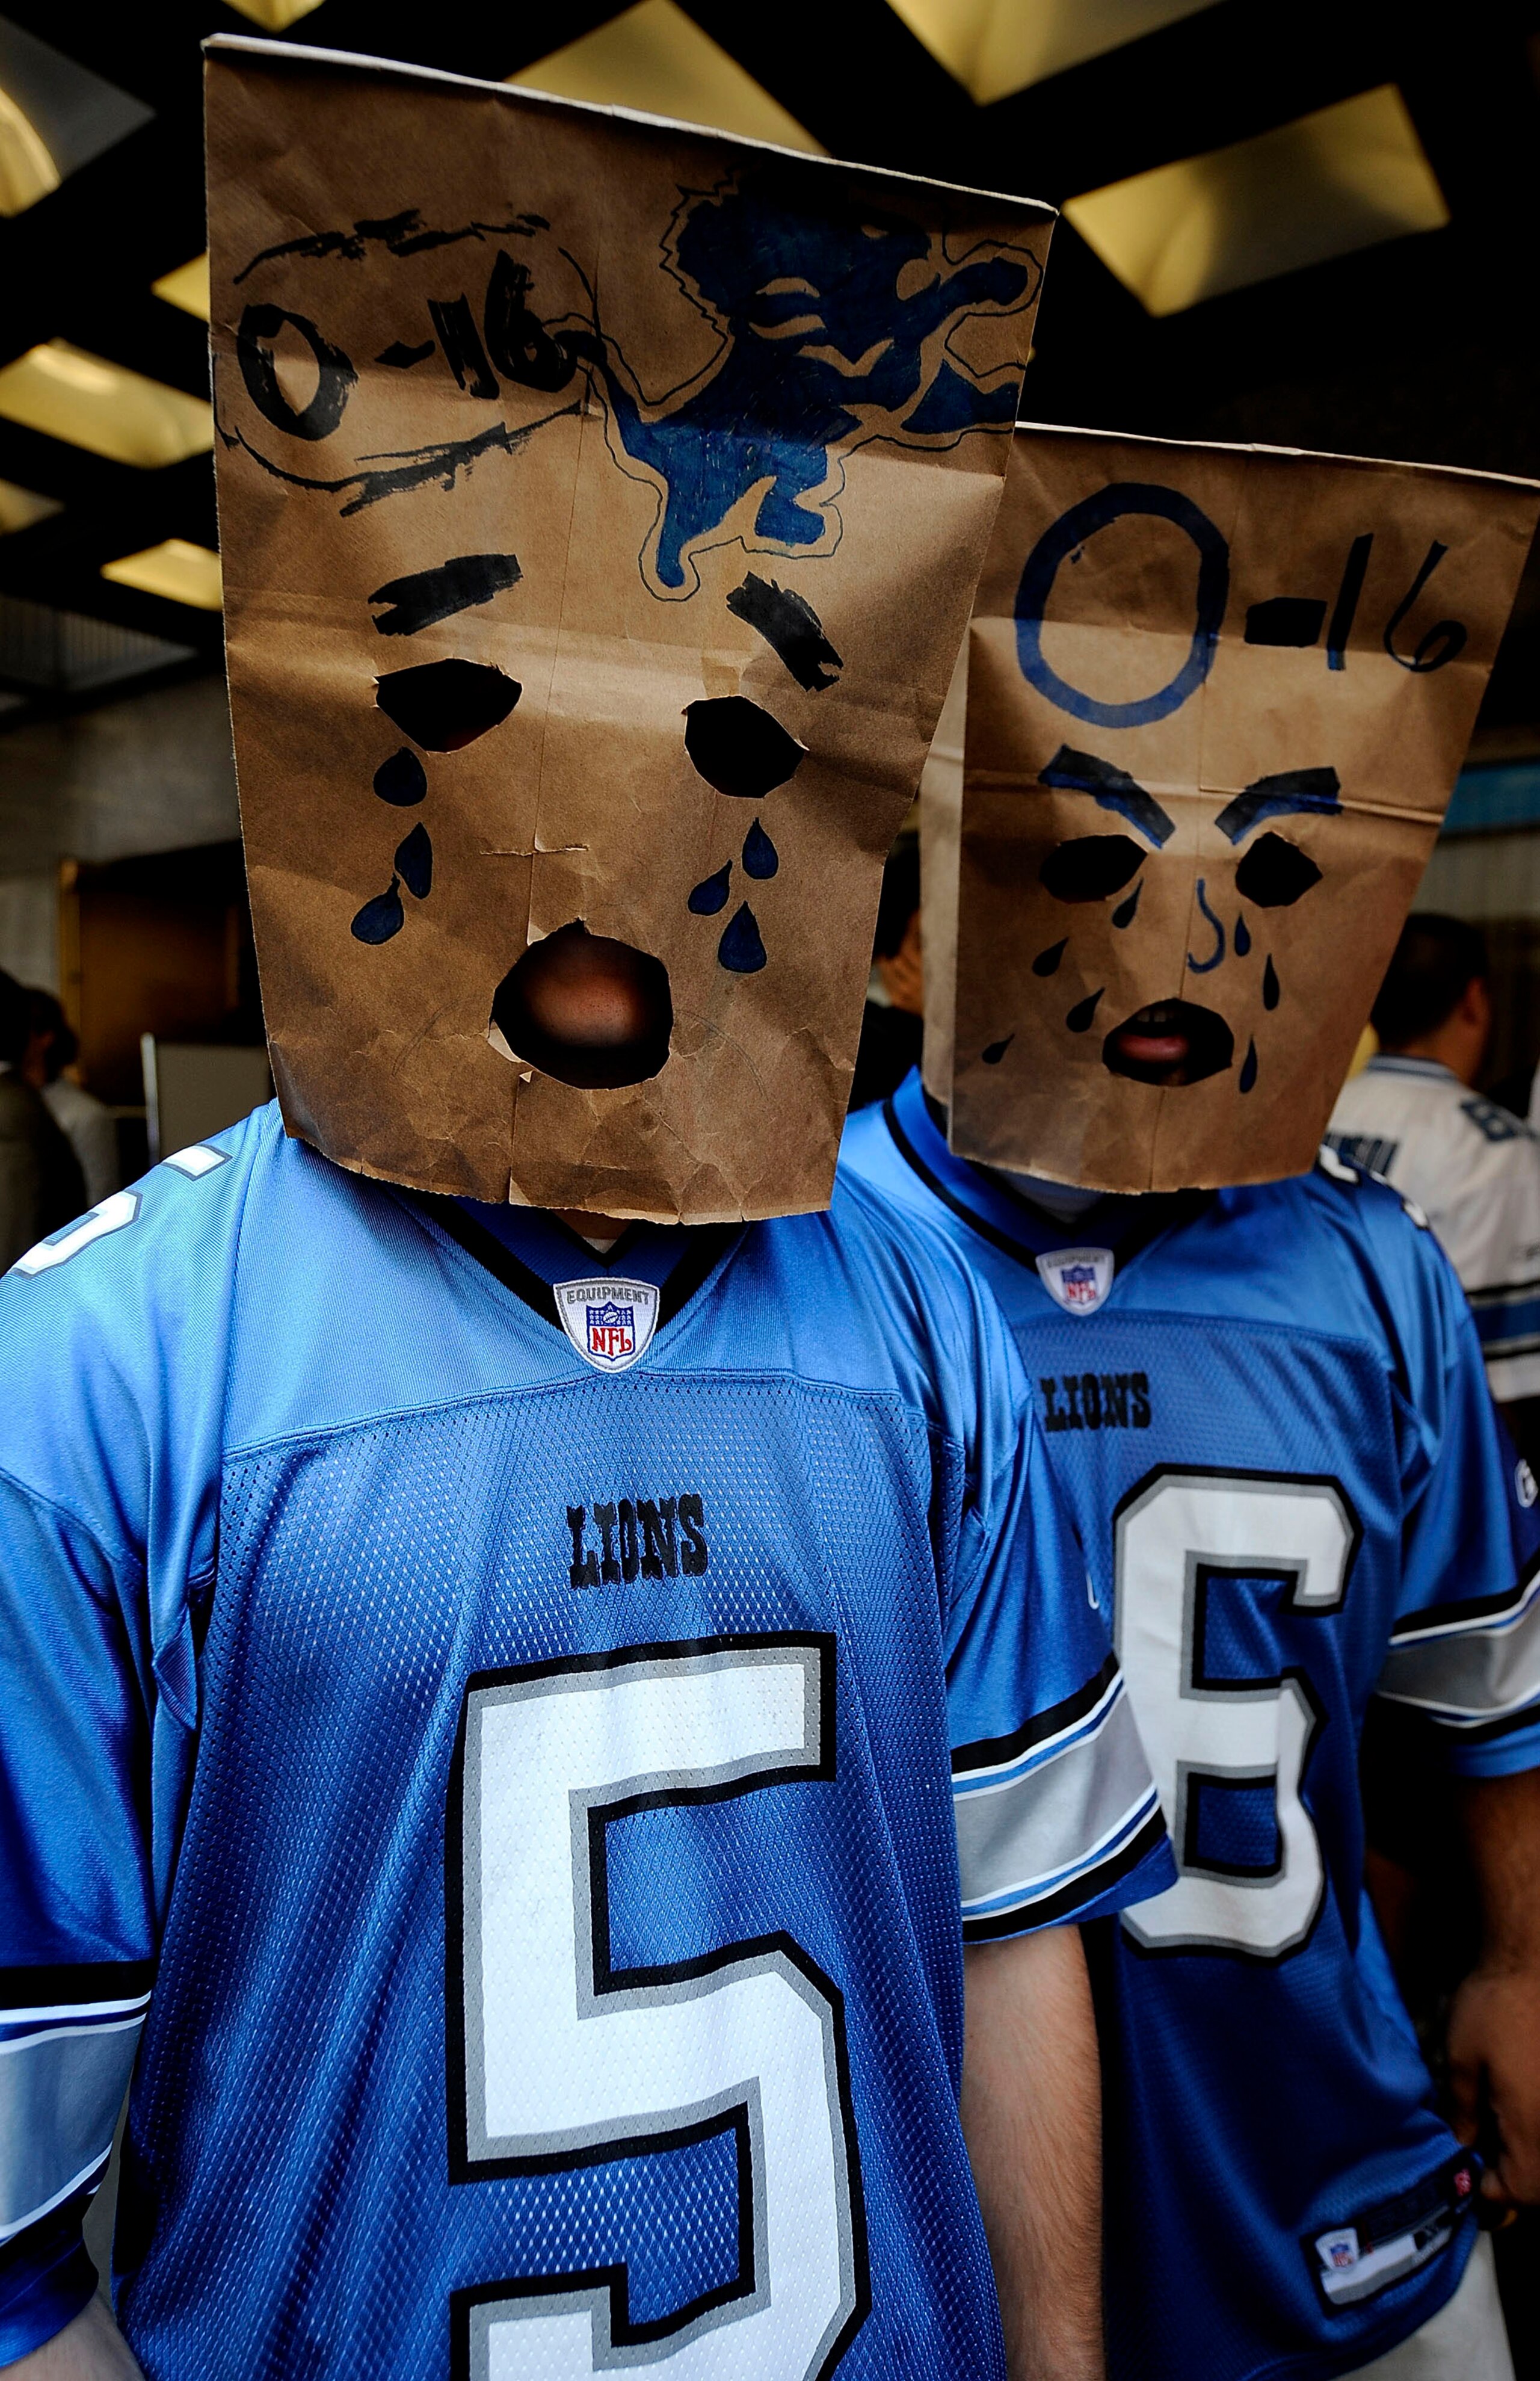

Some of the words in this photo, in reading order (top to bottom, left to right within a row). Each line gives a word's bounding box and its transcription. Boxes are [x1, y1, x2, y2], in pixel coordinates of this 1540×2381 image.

[1014, 483, 1467, 727] 0-16
[566, 1286, 650, 1305] EQUIPMENT
[1067, 1280, 1096, 1301] NFL
[591, 1327, 632, 1357] NFL
[1040, 1373, 1151, 1431] LIONS
[566, 1493, 707, 1590] LIONS
[1113, 1463, 1363, 1966] 6
[445, 1632, 872, 2381] 5
